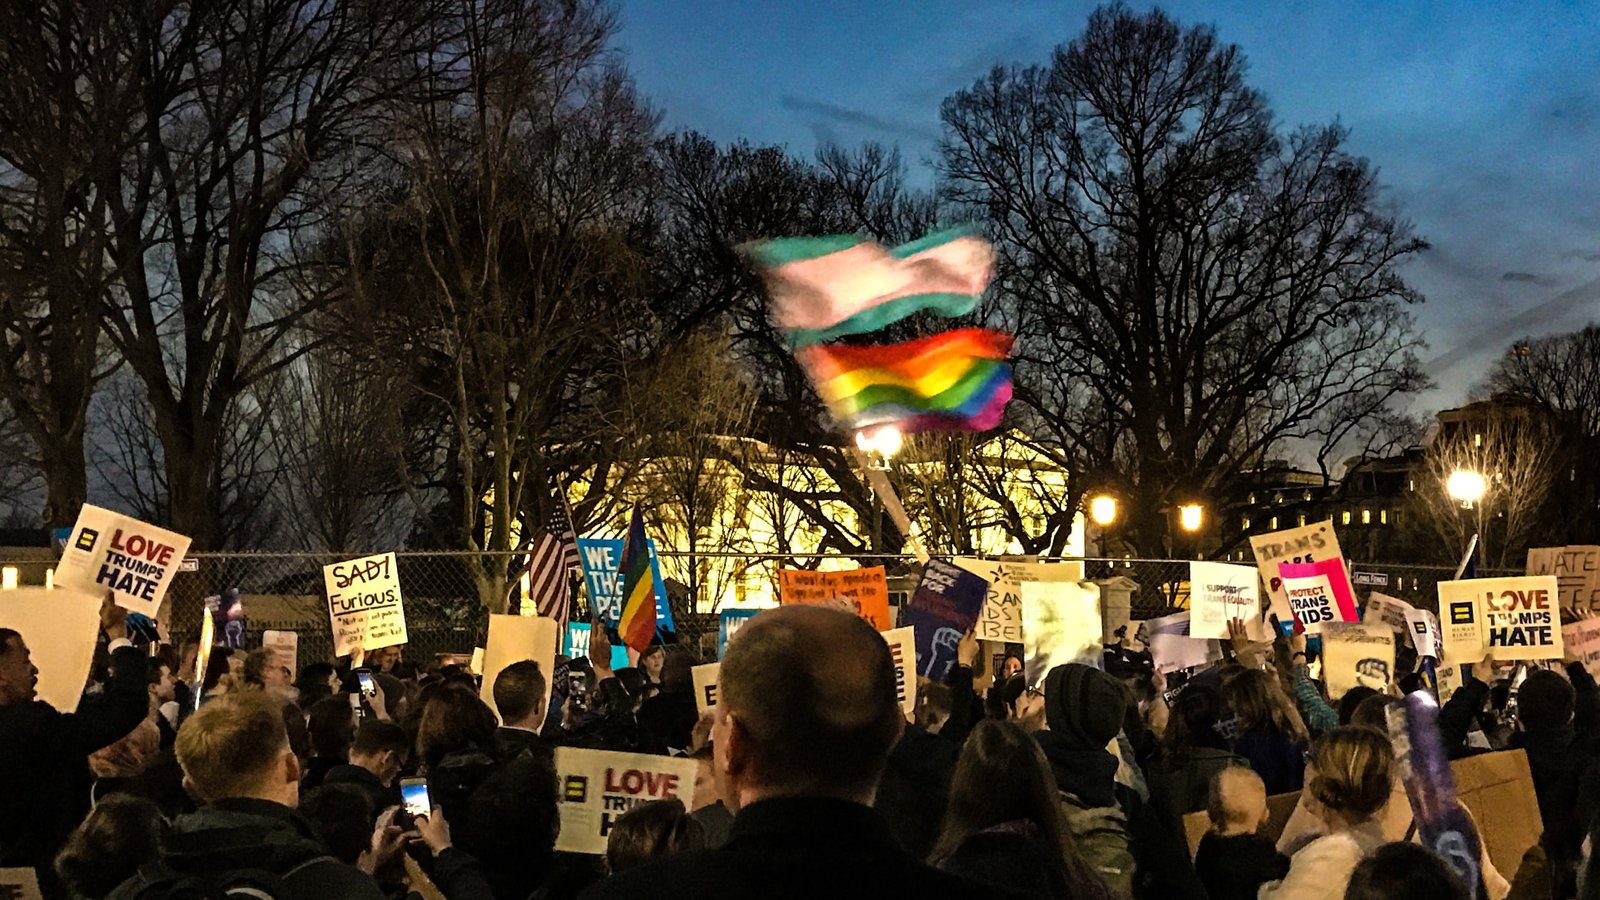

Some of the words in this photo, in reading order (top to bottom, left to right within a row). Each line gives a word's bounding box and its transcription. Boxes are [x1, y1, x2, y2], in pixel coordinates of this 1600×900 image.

[110, 528, 175, 567] LOVE
[584, 546, 617, 570] WE
[106, 550, 165, 580] TRUMPS
[332, 555, 390, 588] SAD!
[96, 564, 158, 602] HATE
[588, 571, 625, 595] THE
[1206, 584, 1237, 594] SUPPORT
[1290, 586, 1324, 597] PROTECT
[1291, 595, 1329, 609] TRANS
[1486, 590, 1550, 612] LOVE
[1489, 626, 1554, 647] HATE
[604, 767, 680, 798] LOVE
